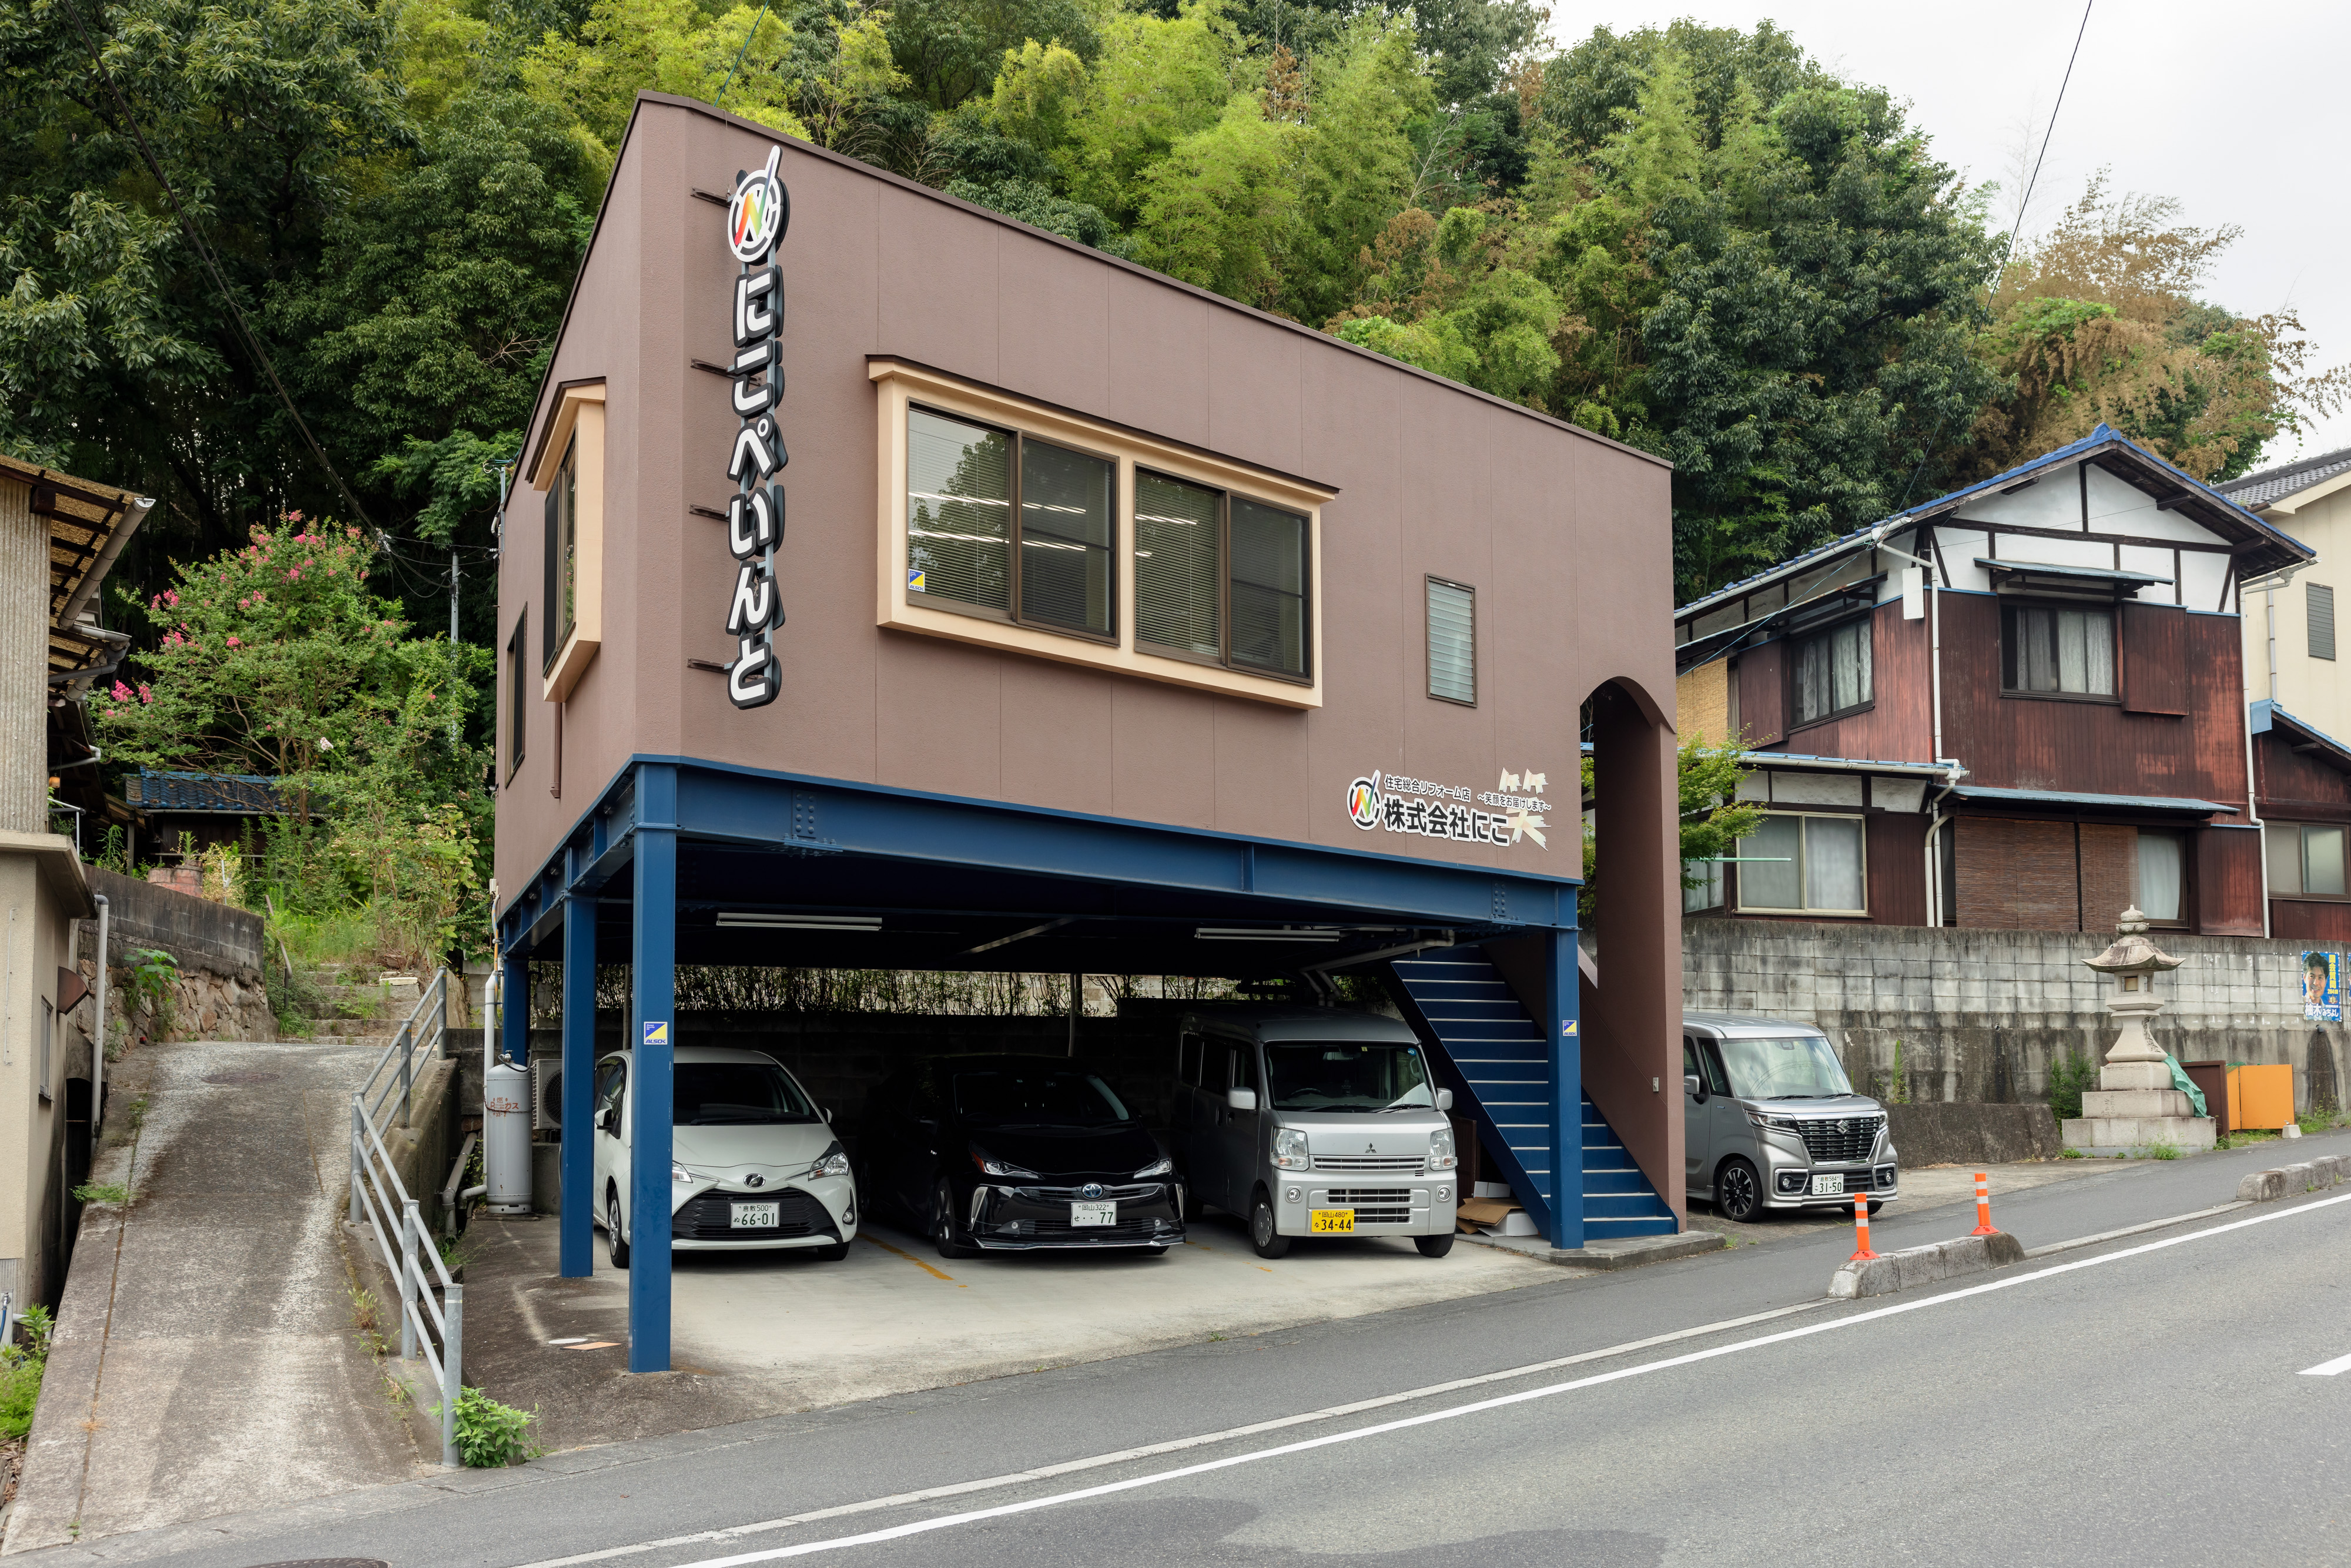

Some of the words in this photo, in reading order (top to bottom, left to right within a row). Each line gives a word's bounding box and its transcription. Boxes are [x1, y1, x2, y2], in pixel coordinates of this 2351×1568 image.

[728, 272, 776, 703] にこぺいんと
[1385, 775, 1471, 801] 住宅総合リフォーム店
[1384, 797, 1508, 843] 株式会社にこ
[2305, 1003, 2322, 1017] 柚木
[2322, 1009, 2339, 1017] みちよし
[1819, 1182, 1842, 1192] 31-50
[741, 1212, 775, 1225] 66-01
[1321, 1219, 1352, 1231] 34-44
